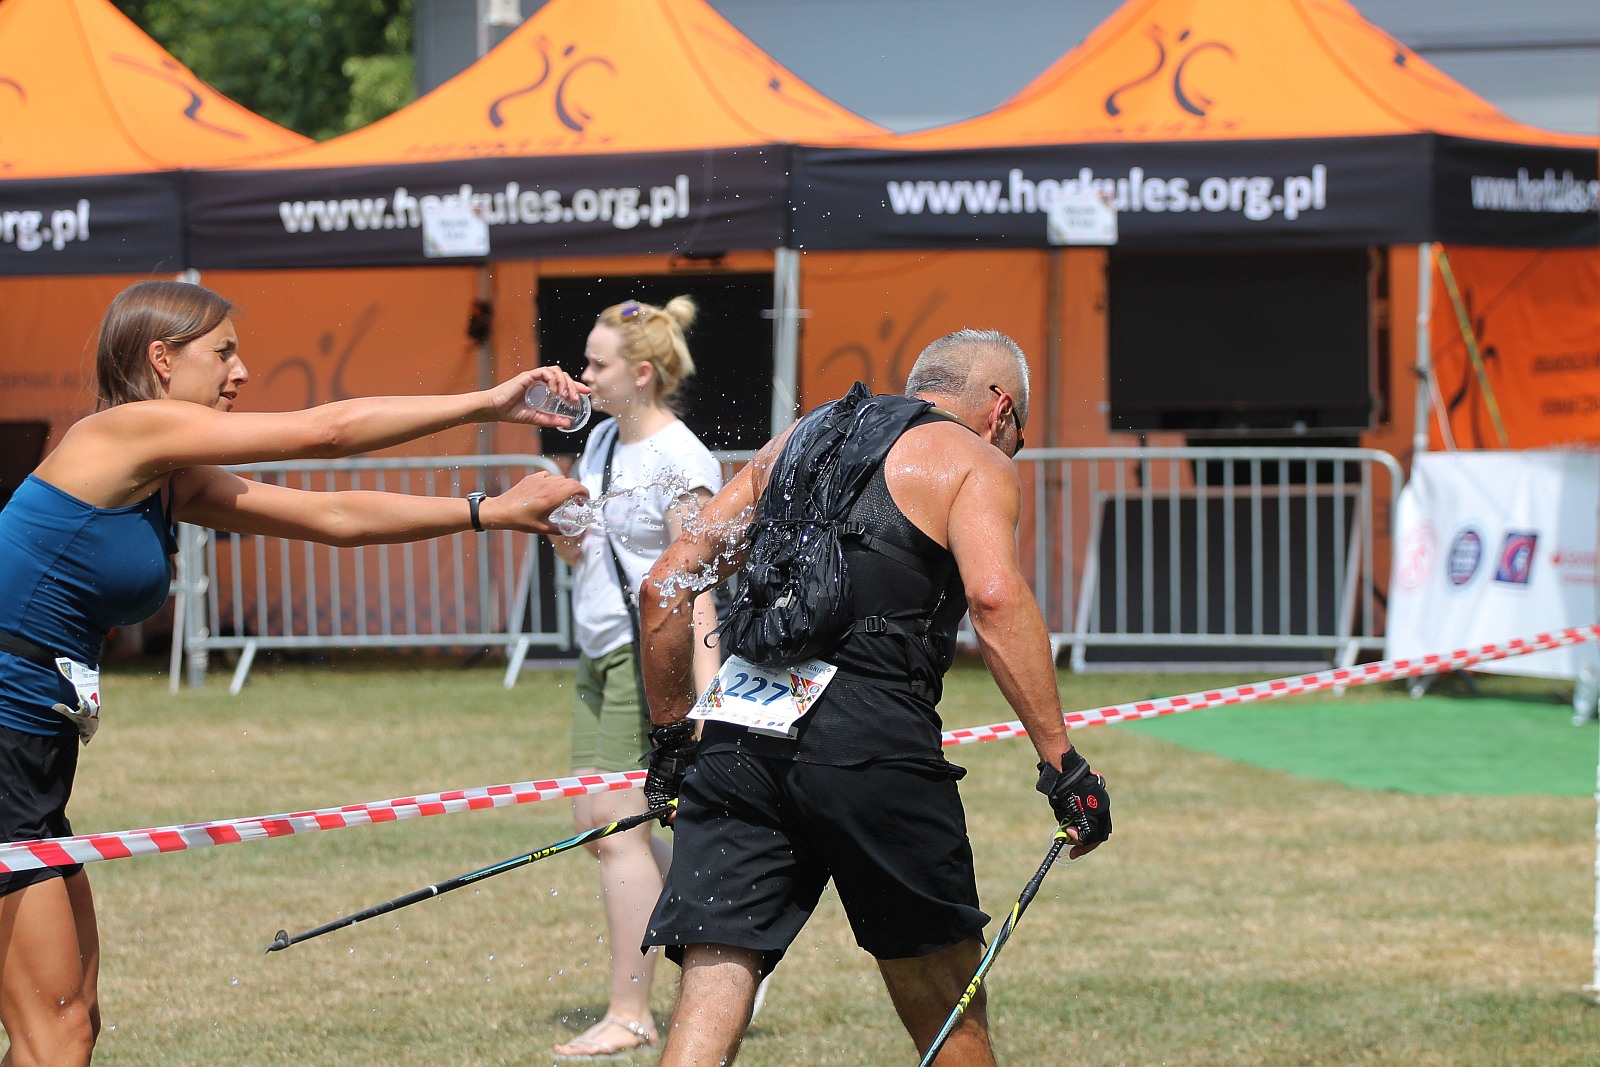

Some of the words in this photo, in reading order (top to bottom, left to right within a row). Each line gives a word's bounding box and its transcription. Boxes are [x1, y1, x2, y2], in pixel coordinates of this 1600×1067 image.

[0, 199, 90, 251] rg.pl
[724, 672, 790, 706] 227
[957, 976, 981, 1013] LEKI
